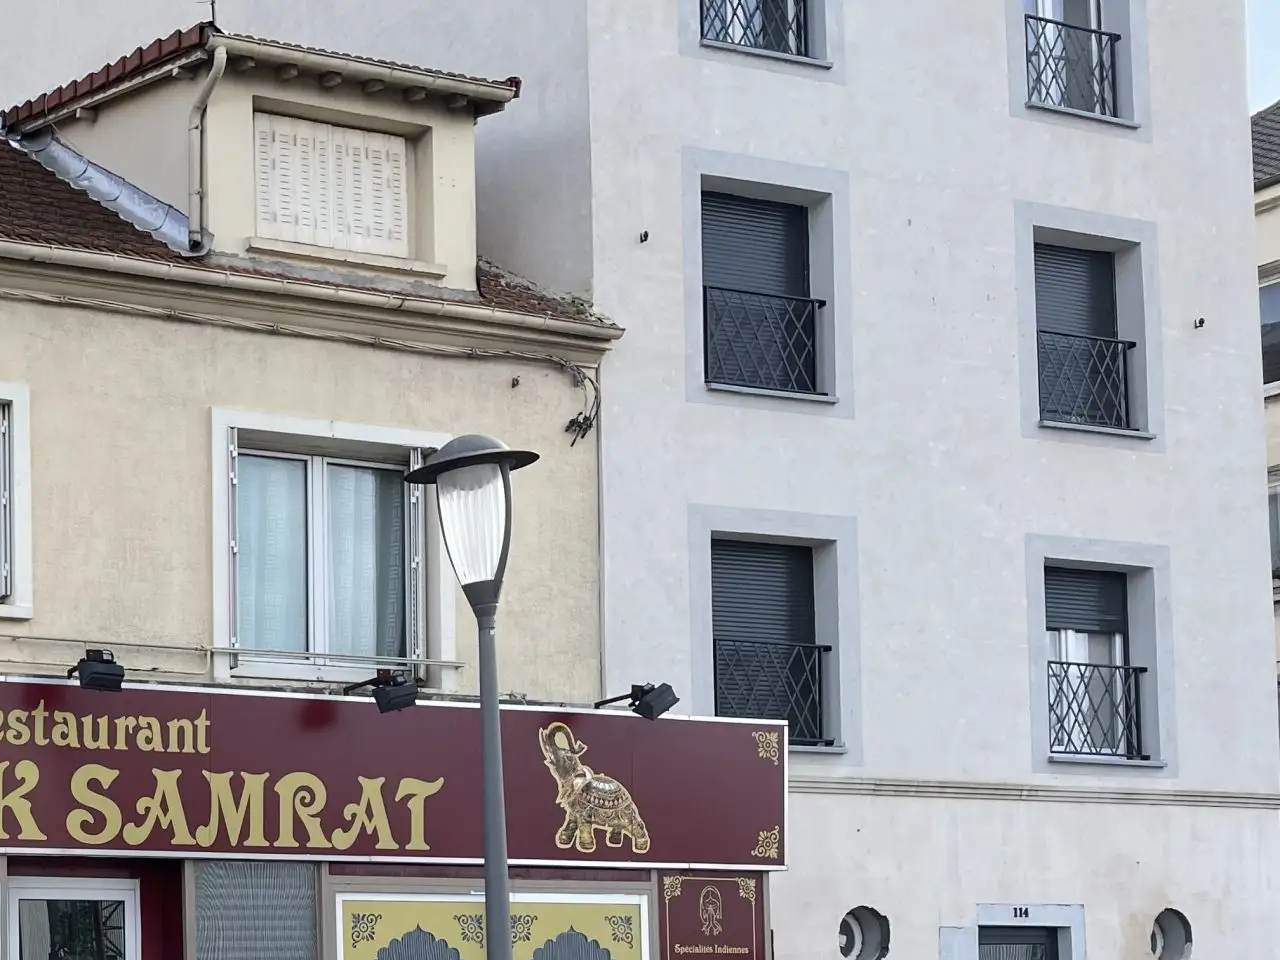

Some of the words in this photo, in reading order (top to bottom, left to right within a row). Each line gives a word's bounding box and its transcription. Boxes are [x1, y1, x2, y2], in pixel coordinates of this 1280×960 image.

[66, 763, 445, 852] SAMRAT
[1013, 907, 1029, 918] 114
[714, 944, 749, 954] Indiennes
